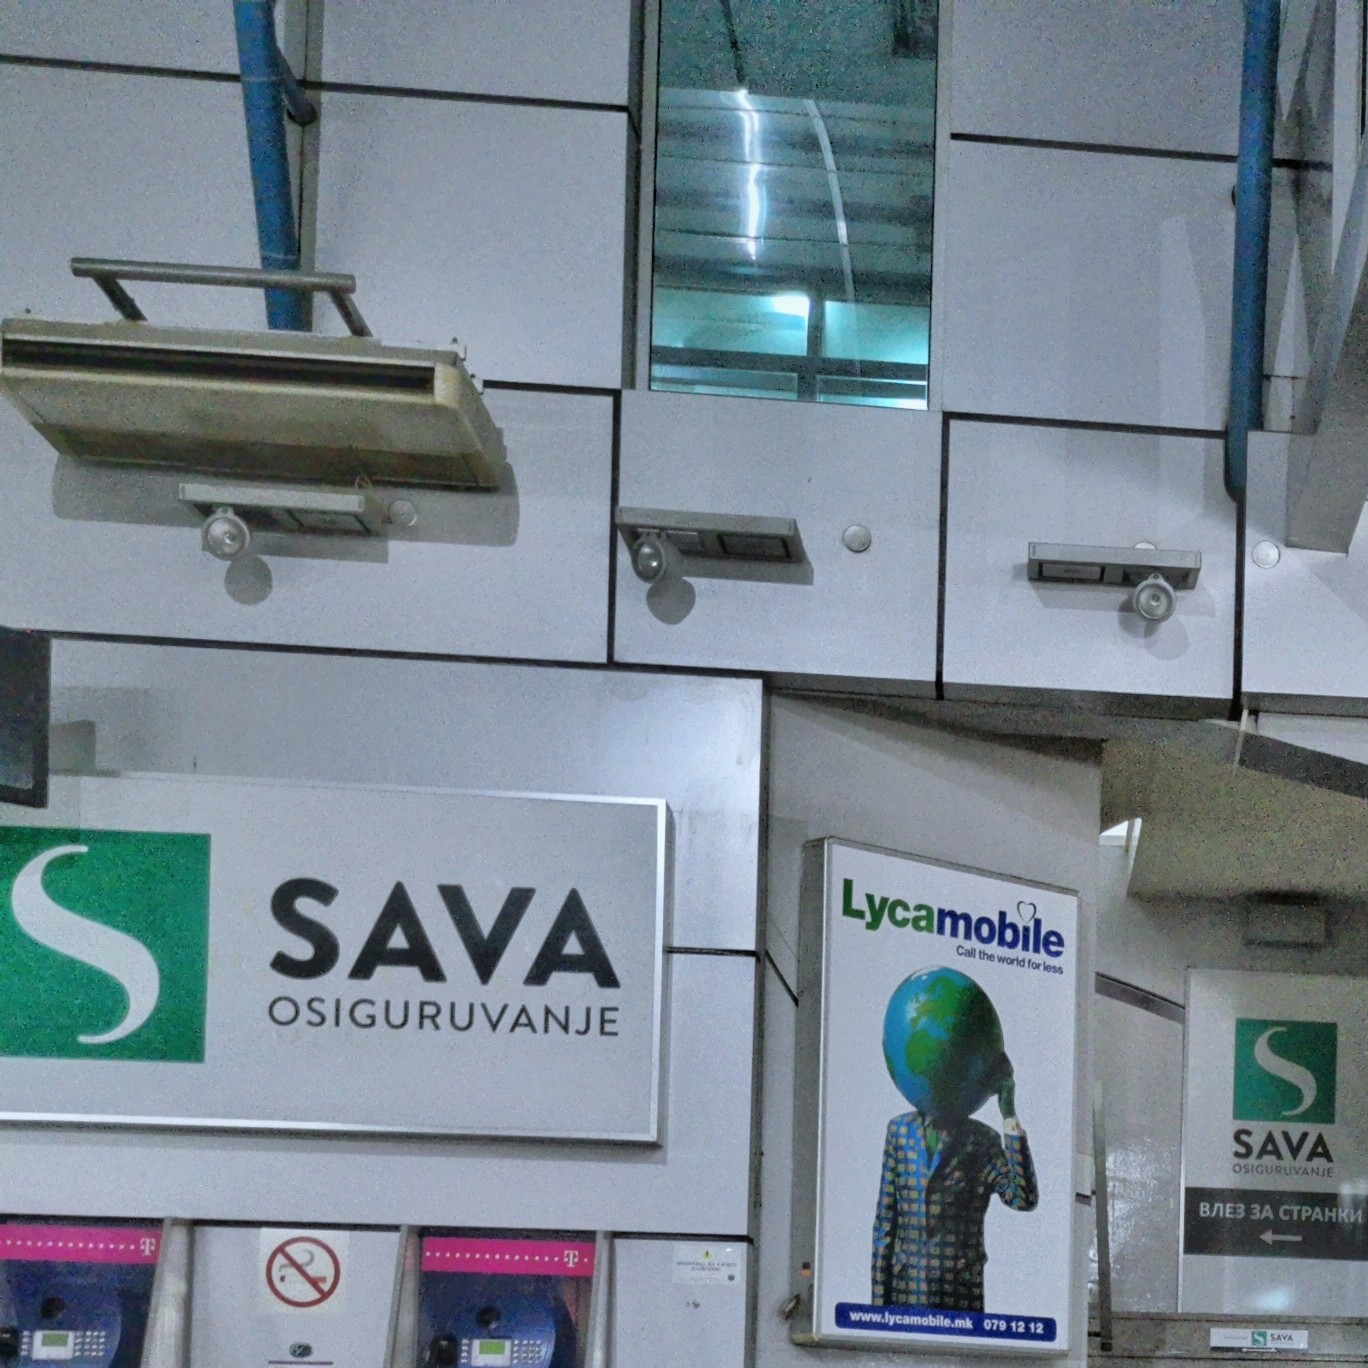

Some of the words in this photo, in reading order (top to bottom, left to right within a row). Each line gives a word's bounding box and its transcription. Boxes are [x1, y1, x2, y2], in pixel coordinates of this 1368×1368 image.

[269, 877, 621, 988] SAVA
[842, 878, 1065, 957] Lycamobile
[956, 945, 976, 958] Call
[979, 950, 995, 963] the
[997, 955, 1025, 968] world
[1028, 959, 1042, 972] for
[1043, 962, 1064, 975] less
[268, 996, 620, 1036] OSIGURUVANJE
[1233, 1128, 1334, 1163] SAVA
[1232, 1163, 1334, 1178] OSIGURUVANJE
[1200, 1203, 1246, 1219] ВЛЕЗ
[1250, 1204, 1274, 1220] ЗА
[1279, 1205, 1364, 1223] СТРАНКИ
[850, 1311, 973, 1329] www.lycamobile.mk
[984, 1319, 1007, 1331] 079
[1010, 1321, 1025, 1332] 12
[1029, 1322, 1044, 1333] 12
[1270, 1333, 1294, 1342] SAVA
